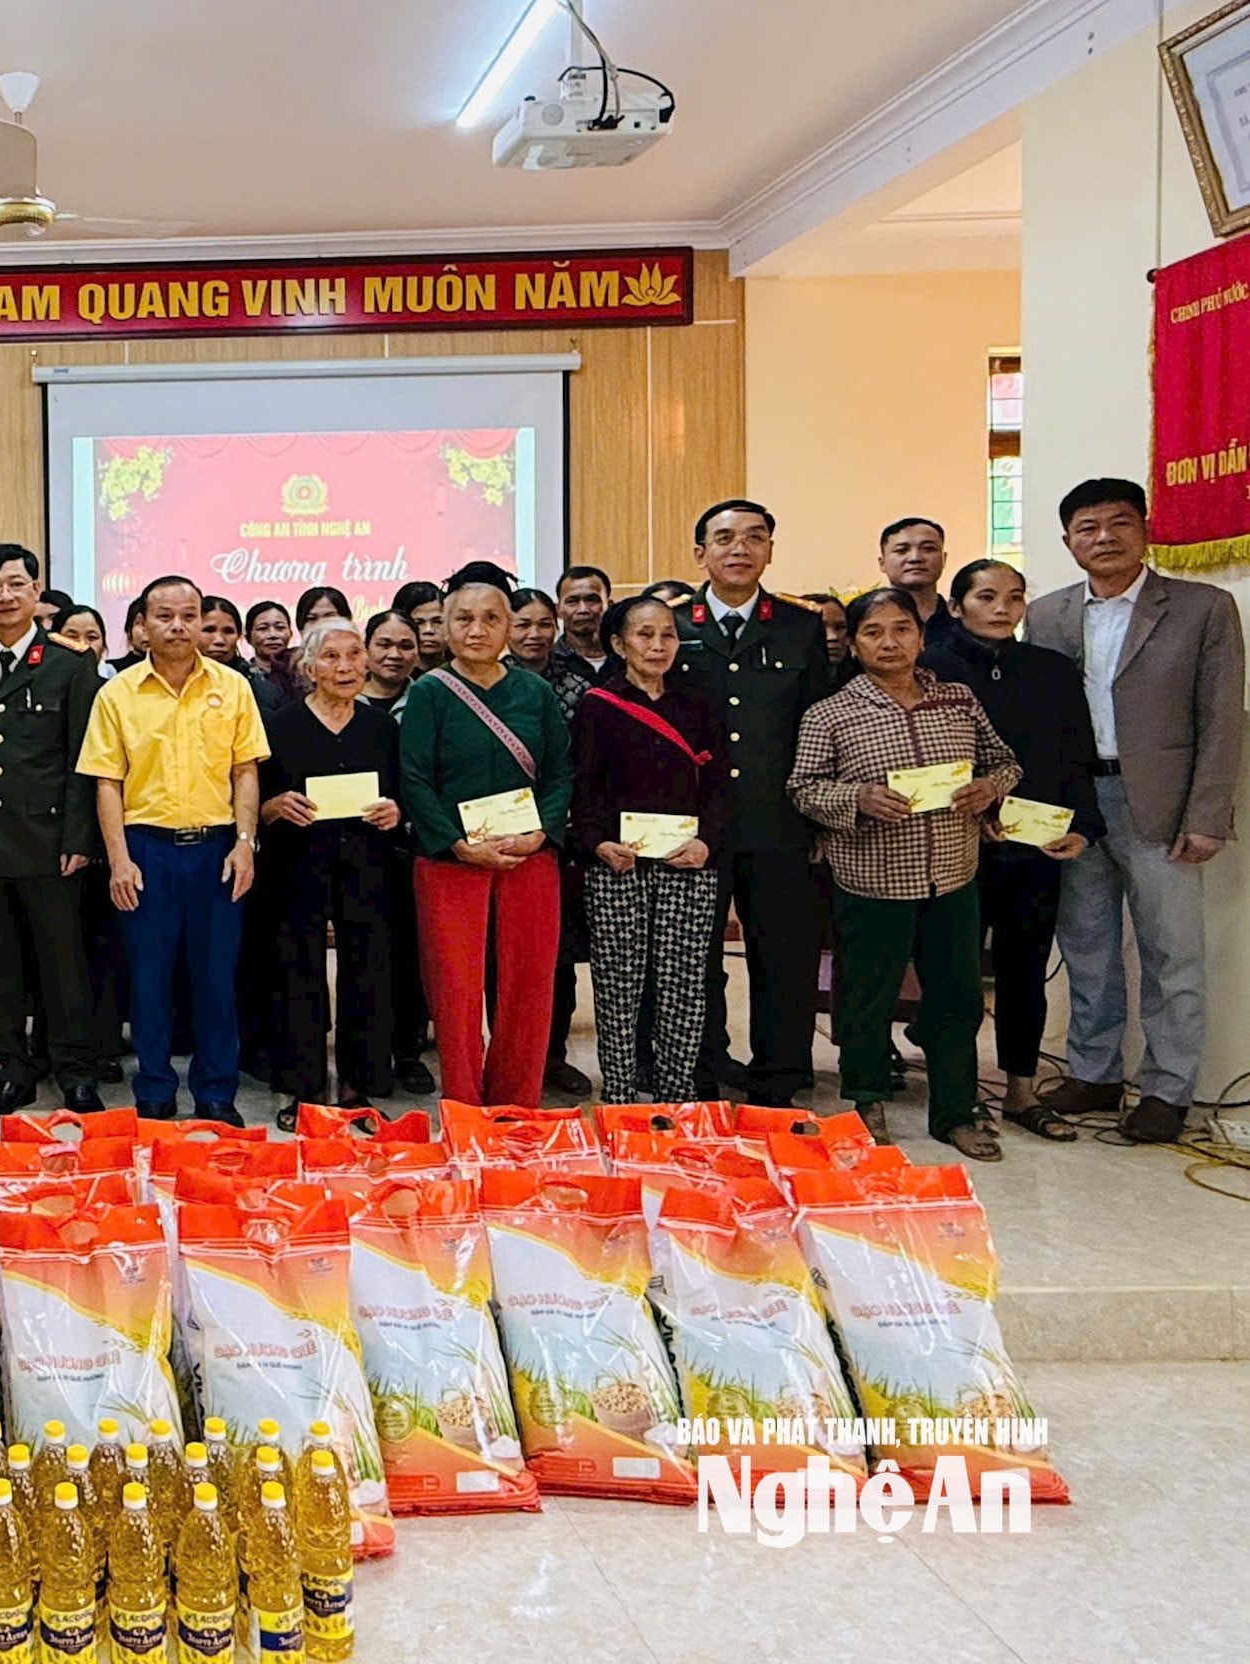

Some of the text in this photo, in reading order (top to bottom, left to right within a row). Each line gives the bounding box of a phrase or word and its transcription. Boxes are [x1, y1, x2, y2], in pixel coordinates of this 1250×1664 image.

[78, 279, 230, 325] QUANG
[241, 278, 346, 316] VINH
[362, 264, 496, 314] MUÔN
[514, 260, 620, 311] NĂM
[1201, 453, 1215, 484] VỊ
[240, 520, 271, 538] CÔNG
[273, 522, 290, 537] AN
[321, 519, 351, 539] NGHỆ
[354, 521, 371, 536] AN
[210, 545, 409, 587] Chương trình
